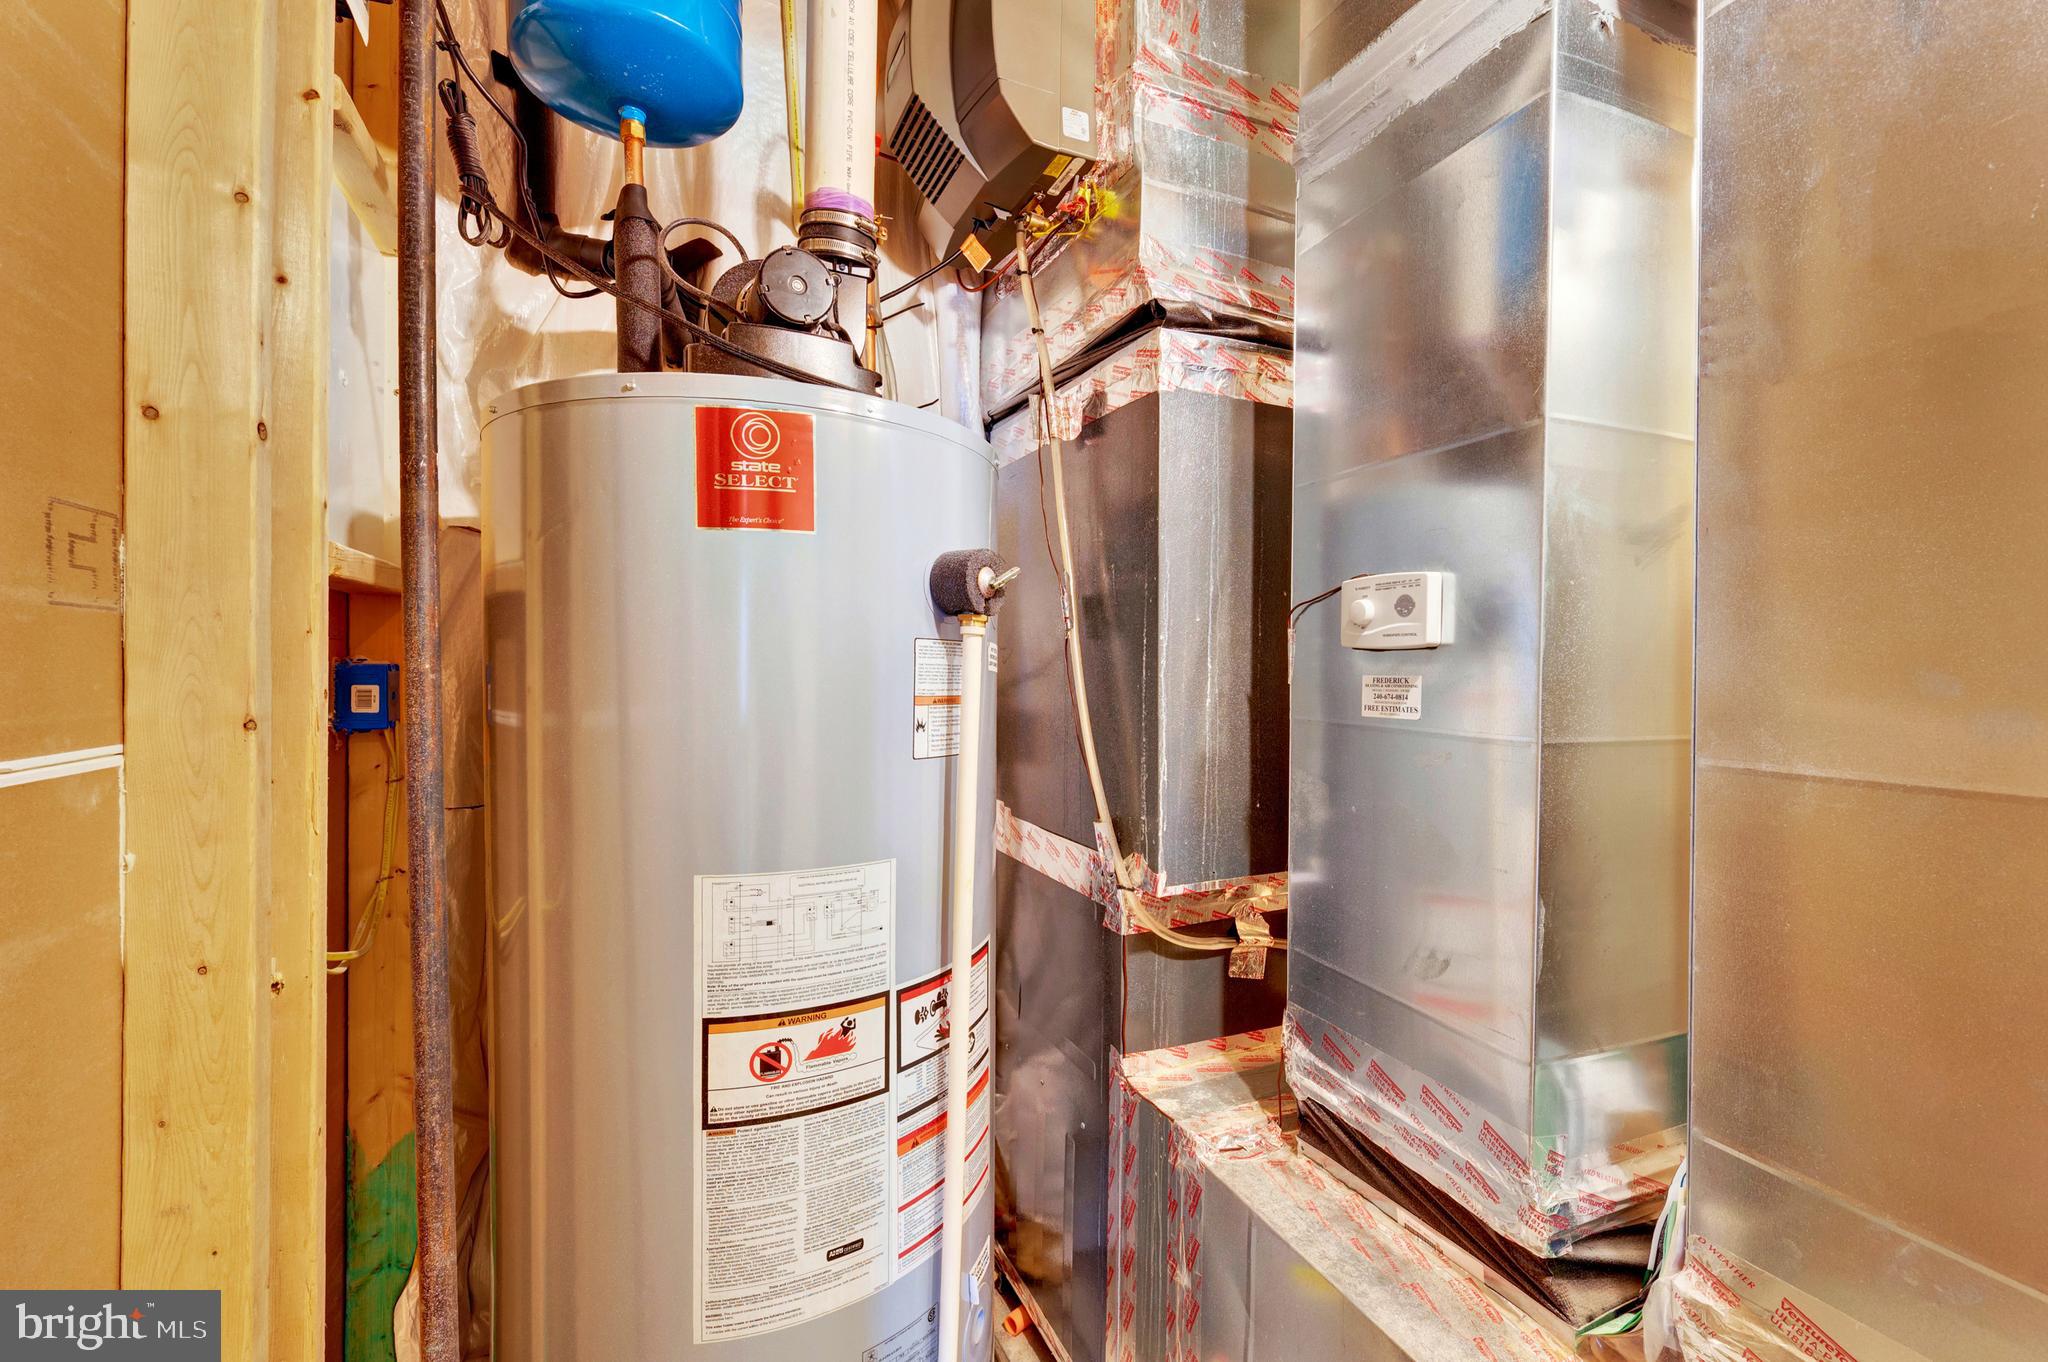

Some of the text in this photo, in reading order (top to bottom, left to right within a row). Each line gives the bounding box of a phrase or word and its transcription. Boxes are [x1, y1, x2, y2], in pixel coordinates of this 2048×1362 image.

[731, 460, 781, 474] state
[713, 472, 794, 489] SELECT
[1372, 676, 1410, 684] FREDERICK
[1381, 705, 1419, 714] ESTIMATES
[788, 1012, 827, 1026] WARNING
[806, 1056, 849, 1070] Flammable Vapors
[1371, 1060, 1406, 1102] VentureTape
[1422, 1086, 1464, 1133] VentureTape
[1483, 1121, 1530, 1175] VentureTape
[1708, 1244, 1756, 1288] WEATHER
